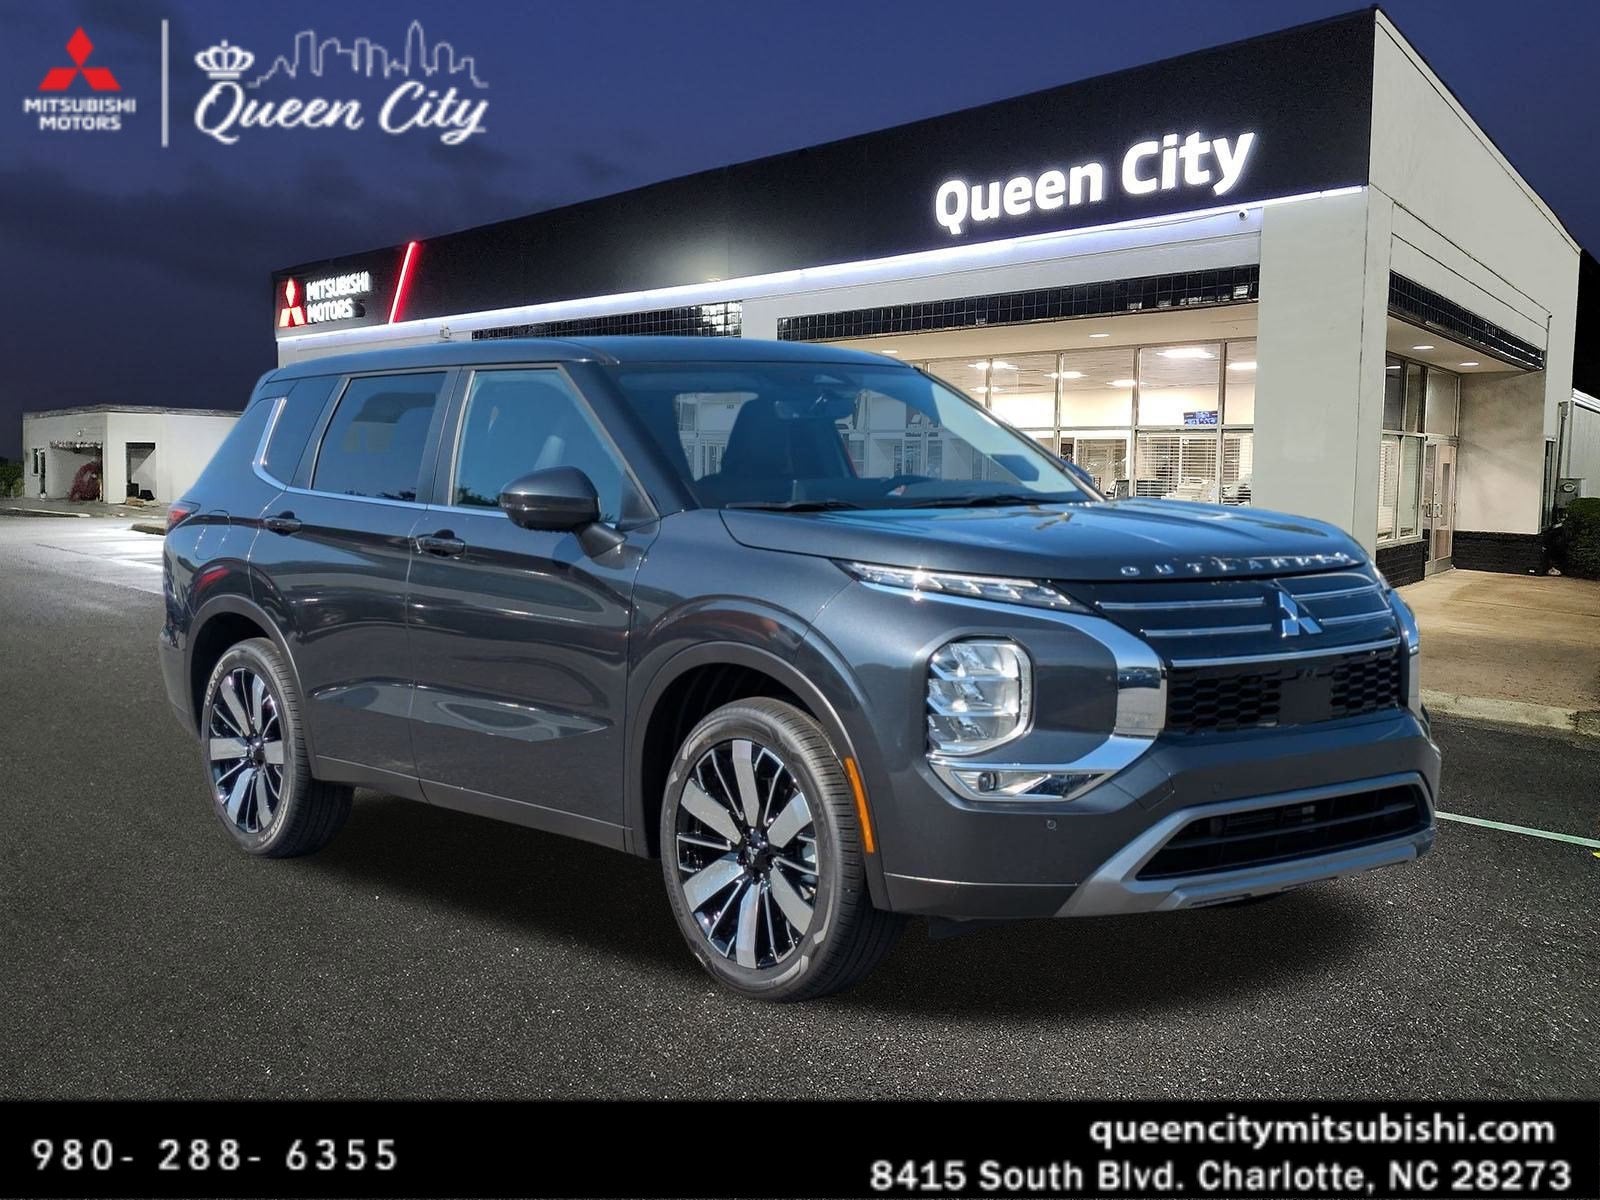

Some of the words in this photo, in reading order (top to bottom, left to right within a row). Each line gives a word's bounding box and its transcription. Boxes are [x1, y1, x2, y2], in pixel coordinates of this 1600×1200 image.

[935, 162, 1103, 235] Queen
[1122, 132, 1254, 195] City
[306, 271, 370, 301] MITSUBISHI
[306, 299, 354, 324] MOTORS
